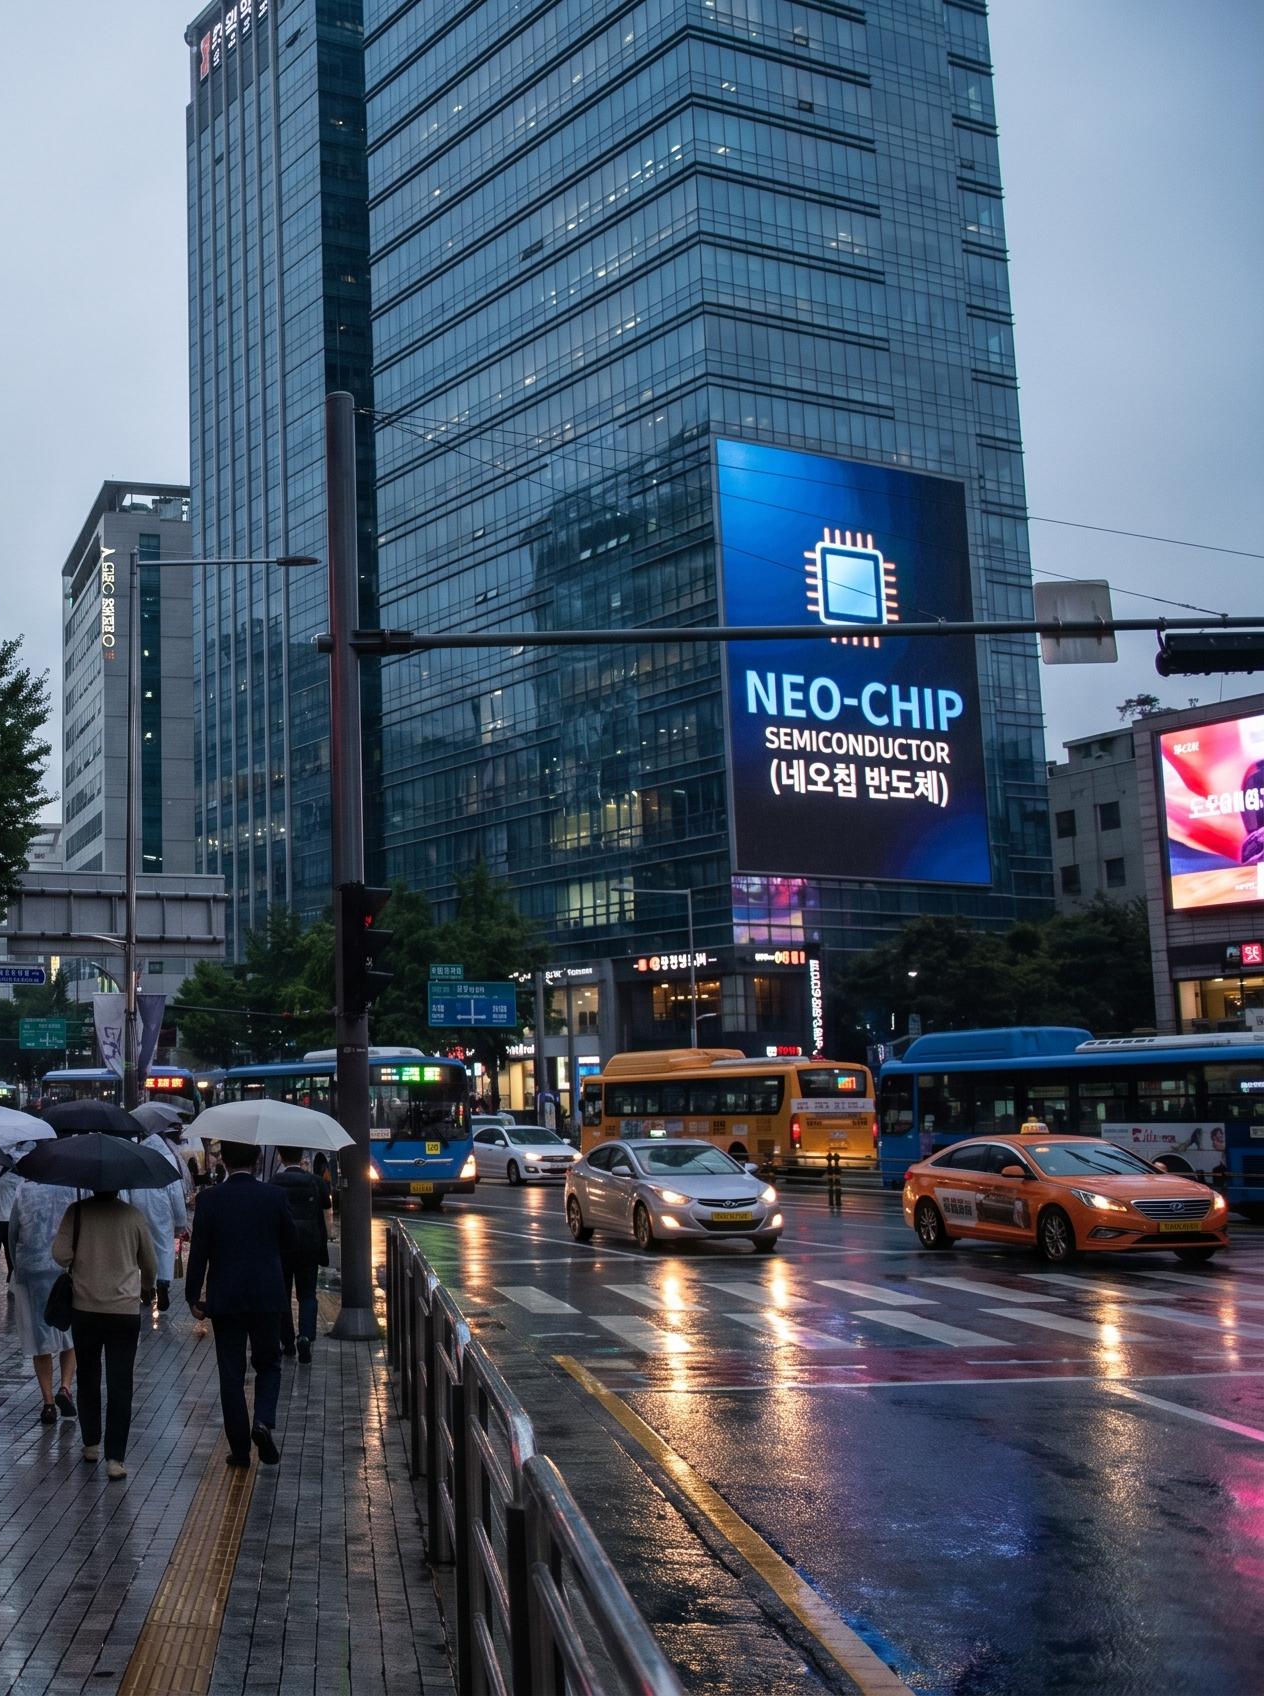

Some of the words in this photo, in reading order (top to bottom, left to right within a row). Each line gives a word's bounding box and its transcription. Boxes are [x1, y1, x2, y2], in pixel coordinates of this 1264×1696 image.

[746, 670, 963, 732] NEO-CHIP
[765, 727, 950, 764] SEMICONDUCTOR
[770, 759, 857, 798] (네오칩
[866, 766, 948, 807] 반도체)
